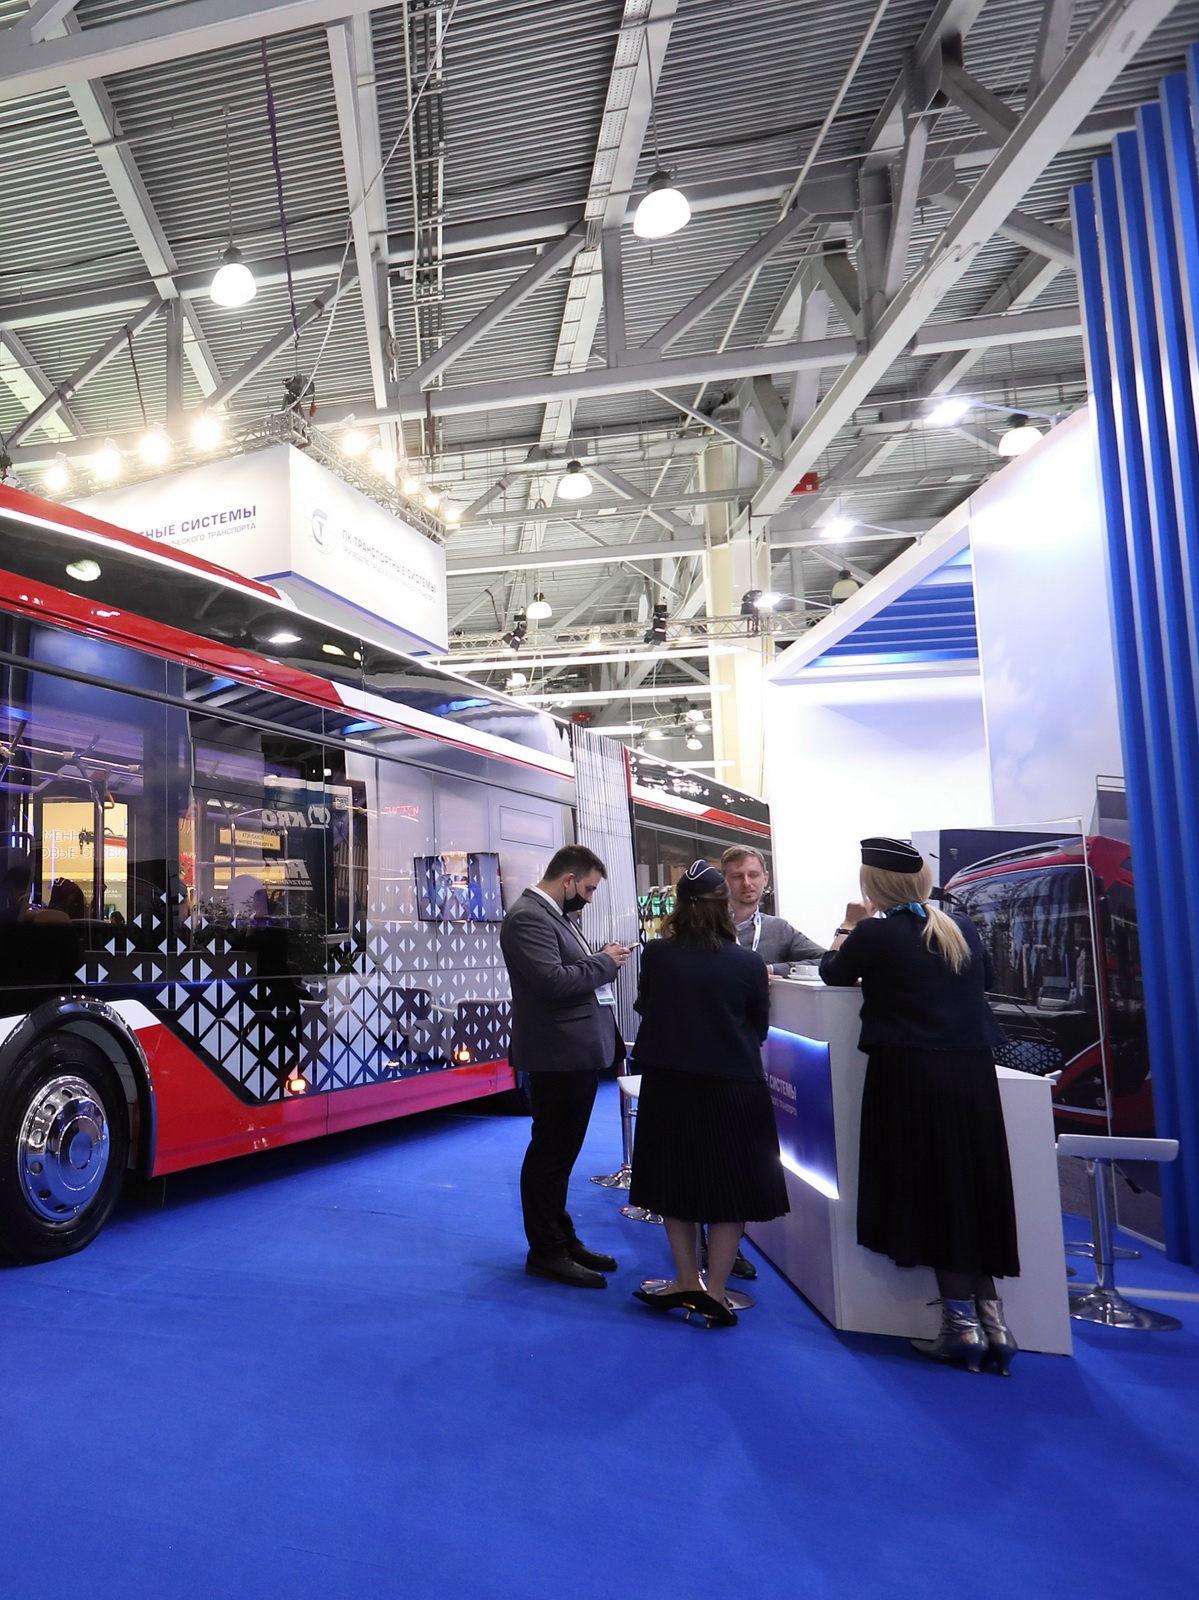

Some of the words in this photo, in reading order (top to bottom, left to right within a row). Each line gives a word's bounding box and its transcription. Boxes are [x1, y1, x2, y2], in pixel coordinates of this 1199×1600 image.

[181, 505, 257, 532] СИСТЕМЫ
[168, 533, 205, 546] ЧЕСКОГО
[207, 523, 257, 539] ТРАНСПОРТА
